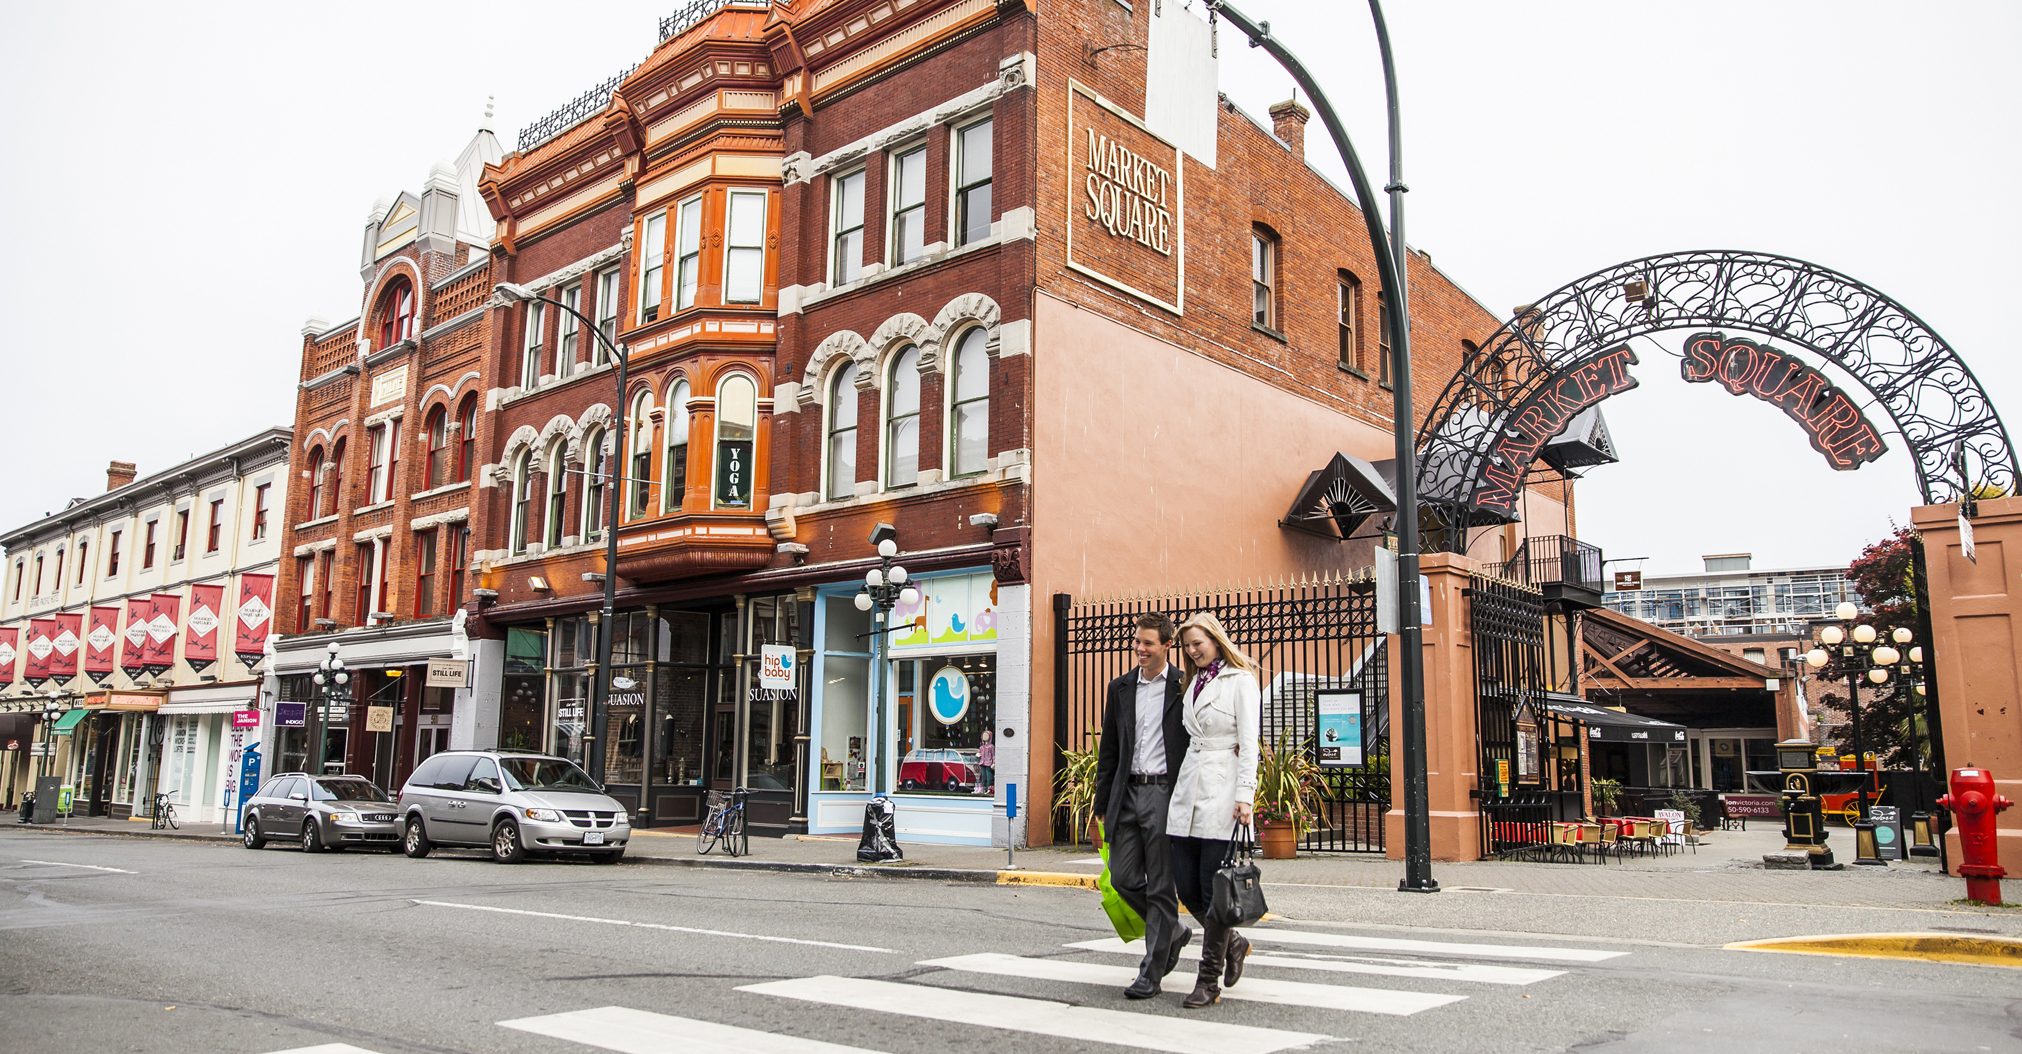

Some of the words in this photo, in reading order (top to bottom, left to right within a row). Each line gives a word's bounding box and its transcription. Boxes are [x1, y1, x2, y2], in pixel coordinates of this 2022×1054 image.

[1086, 127, 1171, 208] MARKET
[1085, 173, 1172, 256] SQUARE
[1688, 339, 1881, 465] SQUARE
[1476, 349, 1631, 510] MARKET
[728, 447, 741, 497] YOGA
[764, 653, 780, 669] hip
[432, 669, 448, 677] STILL
[449, 670, 463, 678] LIFE
[764, 665, 791, 681] baby
[748, 687, 798, 702] SUASION
[558, 708, 572, 717] STILL
[572, 707, 584, 717] LIFE
[230, 734, 243, 747] THE
[248, 758, 256, 766] P
[1657, 810, 1682, 818] AVALON
[1727, 806, 1770, 814] 50-590-6133
